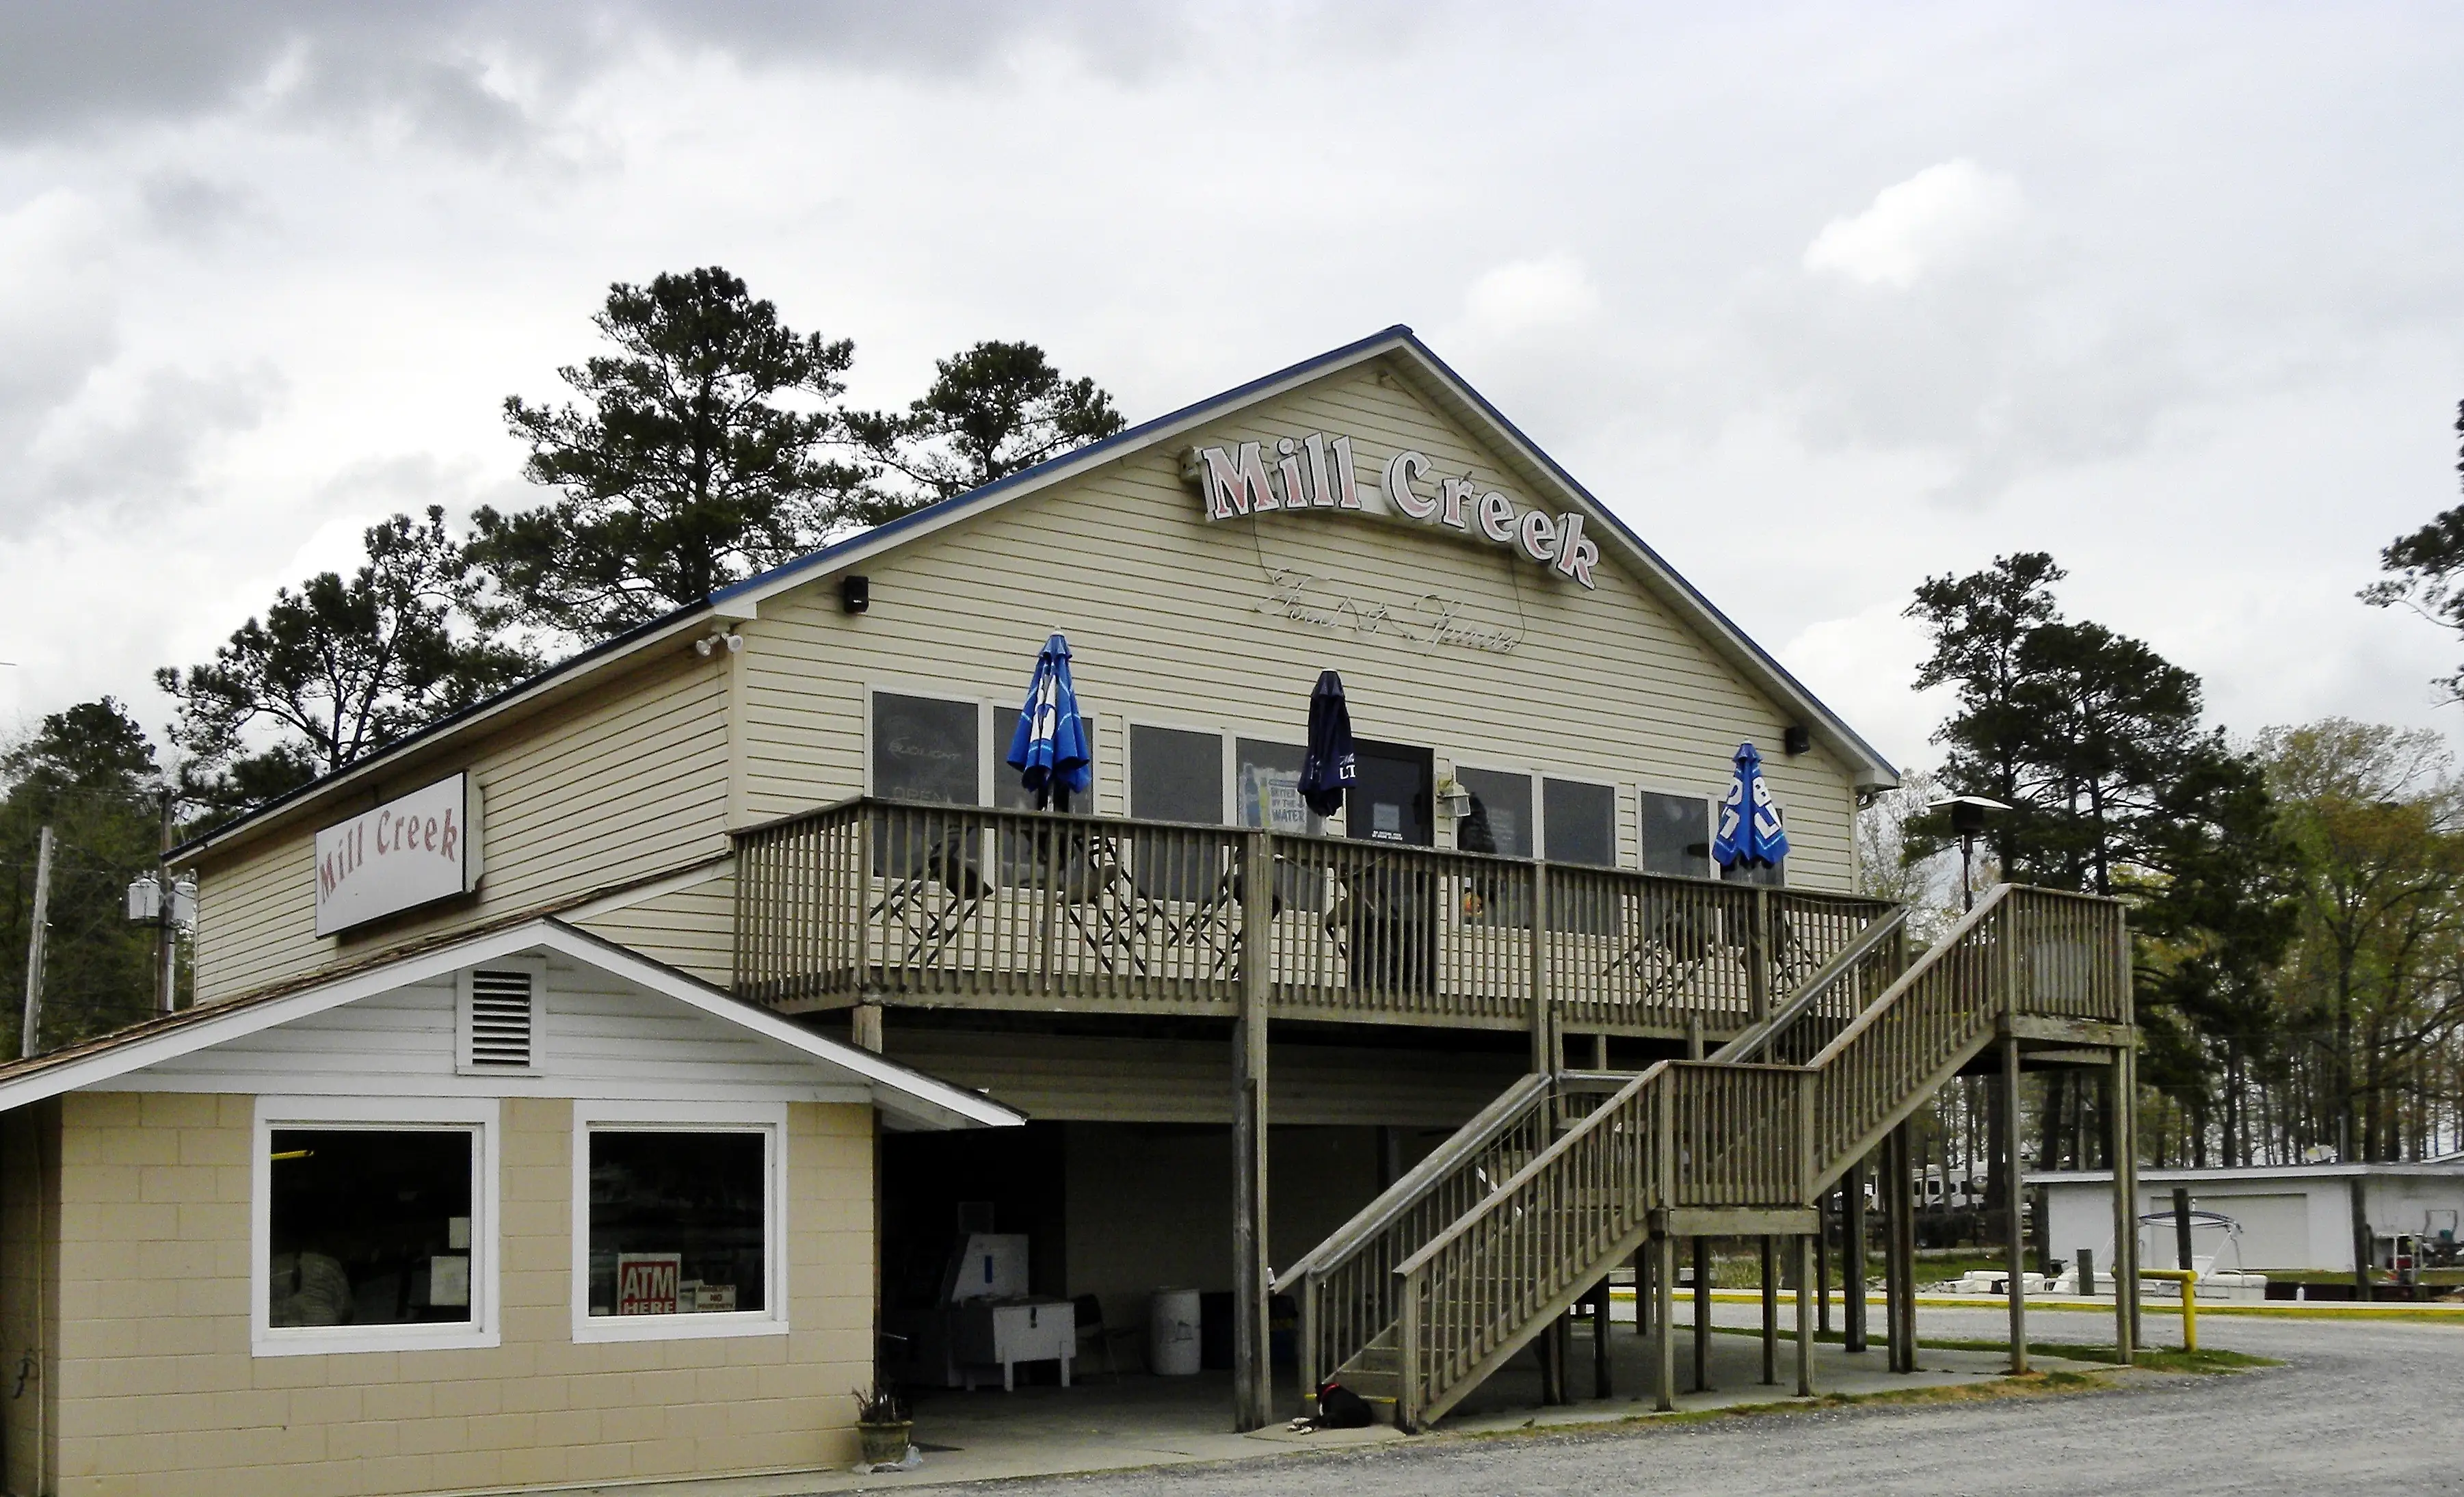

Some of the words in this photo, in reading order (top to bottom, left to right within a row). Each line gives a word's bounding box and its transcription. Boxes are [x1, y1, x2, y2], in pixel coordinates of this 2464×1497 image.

[1201, 432, 1361, 520] Mill
[1386, 450, 1600, 590] Creek
[1256, 567, 1358, 631] Food
[319, 821, 363, 905] Mill
[376, 807, 458, 863] Creek
[622, 1266, 675, 1300] ATM
[623, 1301, 674, 1314] HERE
